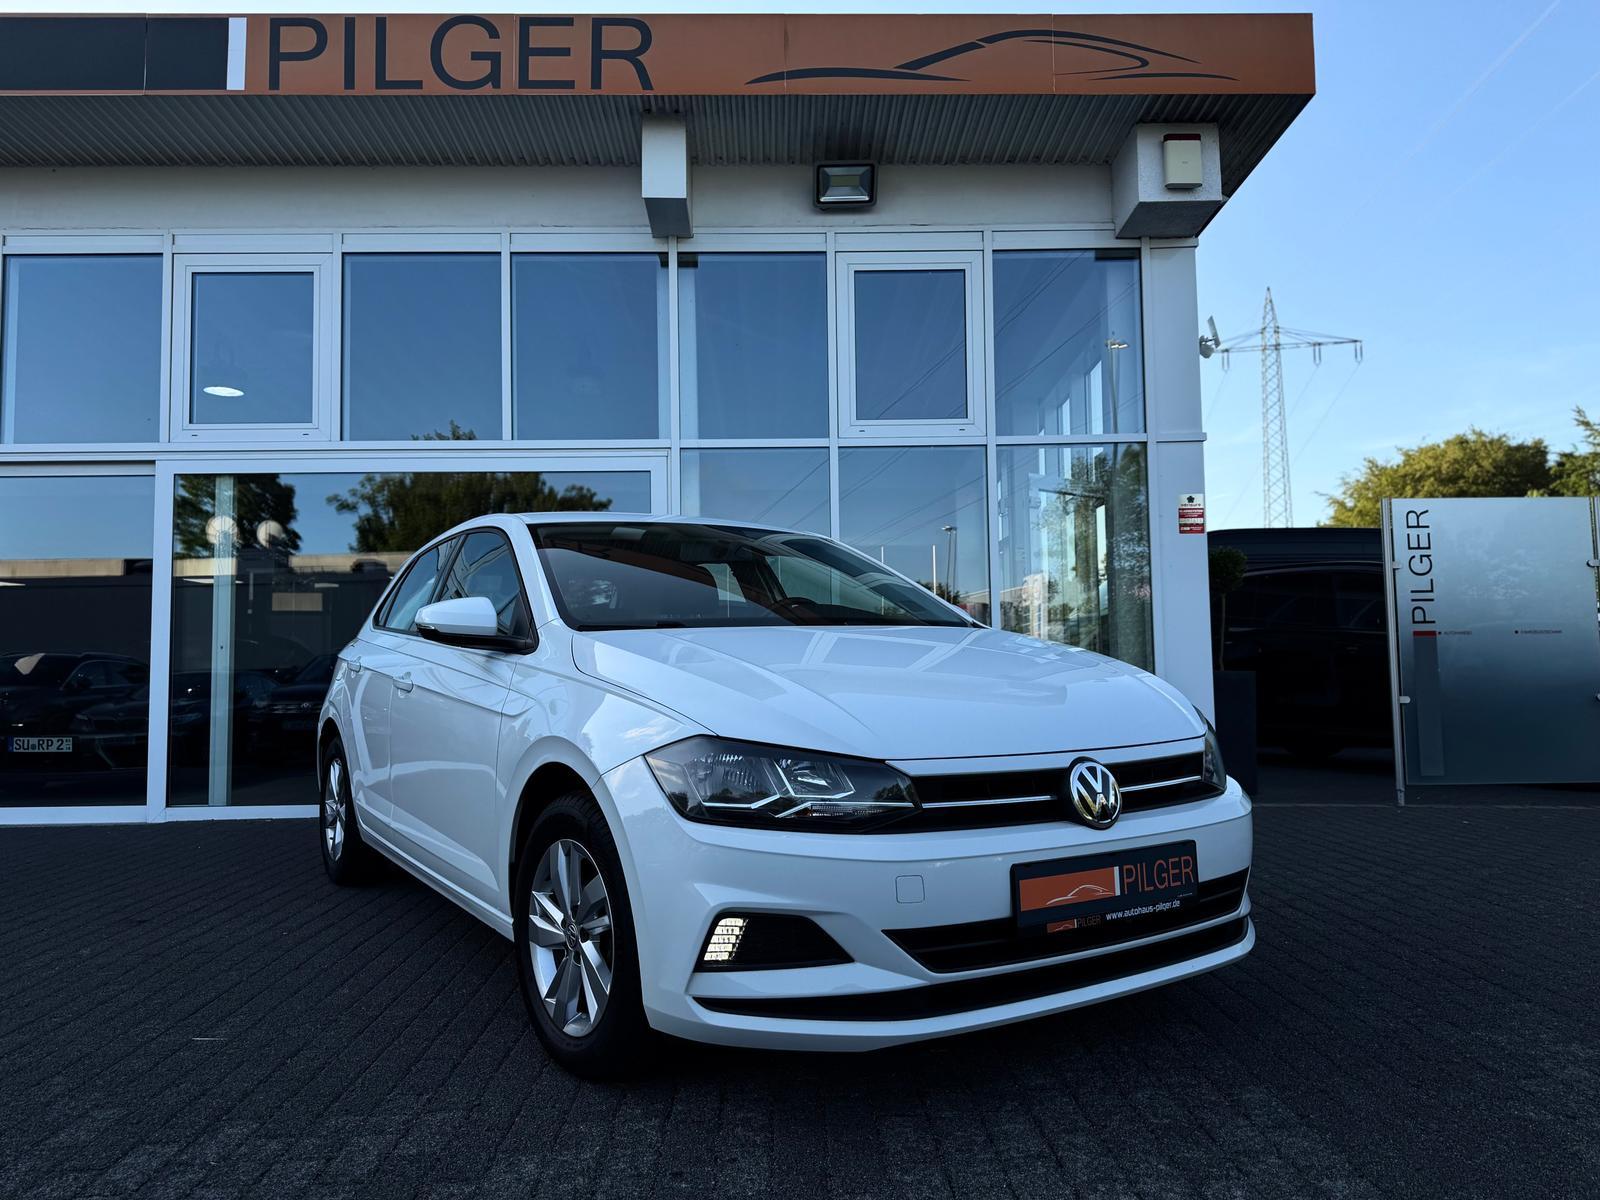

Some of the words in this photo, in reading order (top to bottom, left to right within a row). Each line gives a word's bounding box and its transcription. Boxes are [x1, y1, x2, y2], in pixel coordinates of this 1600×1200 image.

[268, 15, 653, 91] PILGER
[1406, 509, 1436, 624] PILGER
[14, 738, 30, 751] SU
[37, 738, 54, 751] RP
[1123, 856, 1194, 894] PILGER
[1077, 915, 1102, 929] PILGER
[1106, 899, 1181, 921] www.autohaus-pilger.de
